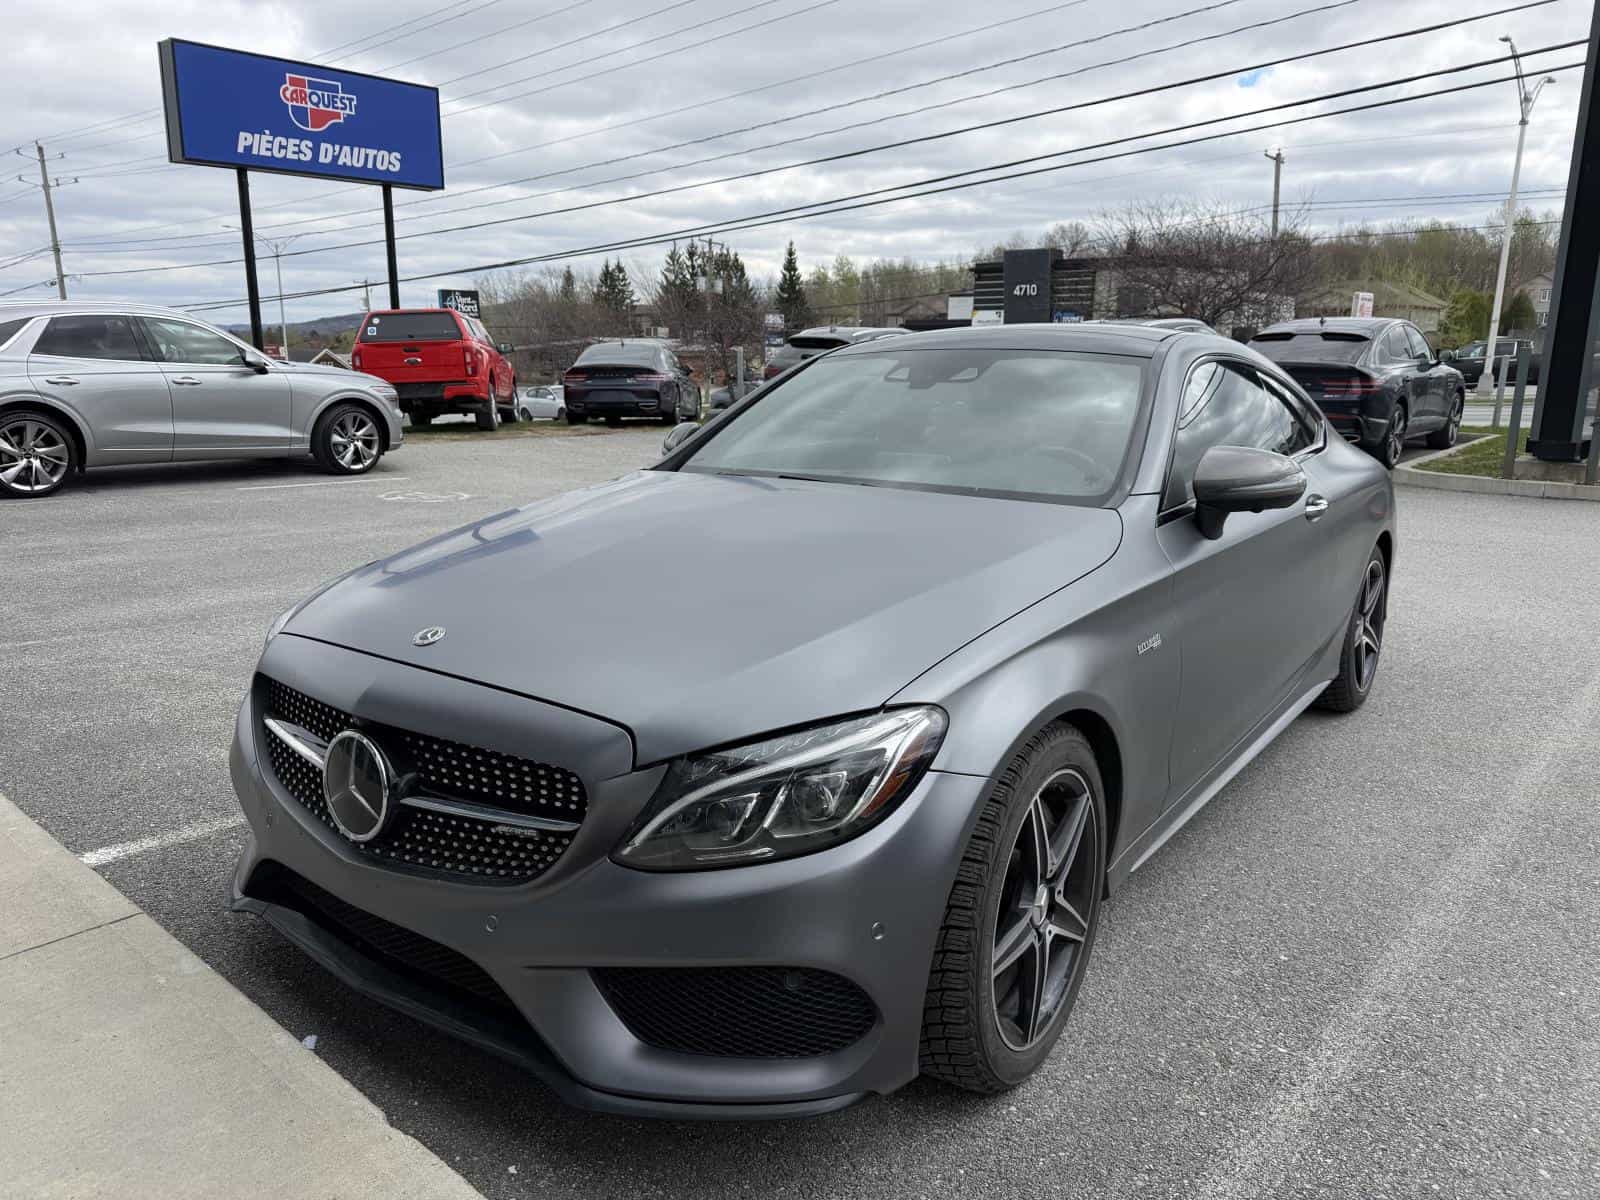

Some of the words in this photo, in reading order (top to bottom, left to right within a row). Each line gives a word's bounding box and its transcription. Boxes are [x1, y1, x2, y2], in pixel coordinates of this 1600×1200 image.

[281, 87, 356, 114] CARQUEST
[237, 131, 313, 161] PIÈCES
[318, 143, 401, 171] D'AUTOS
[1013, 284, 1037, 296] 4710
